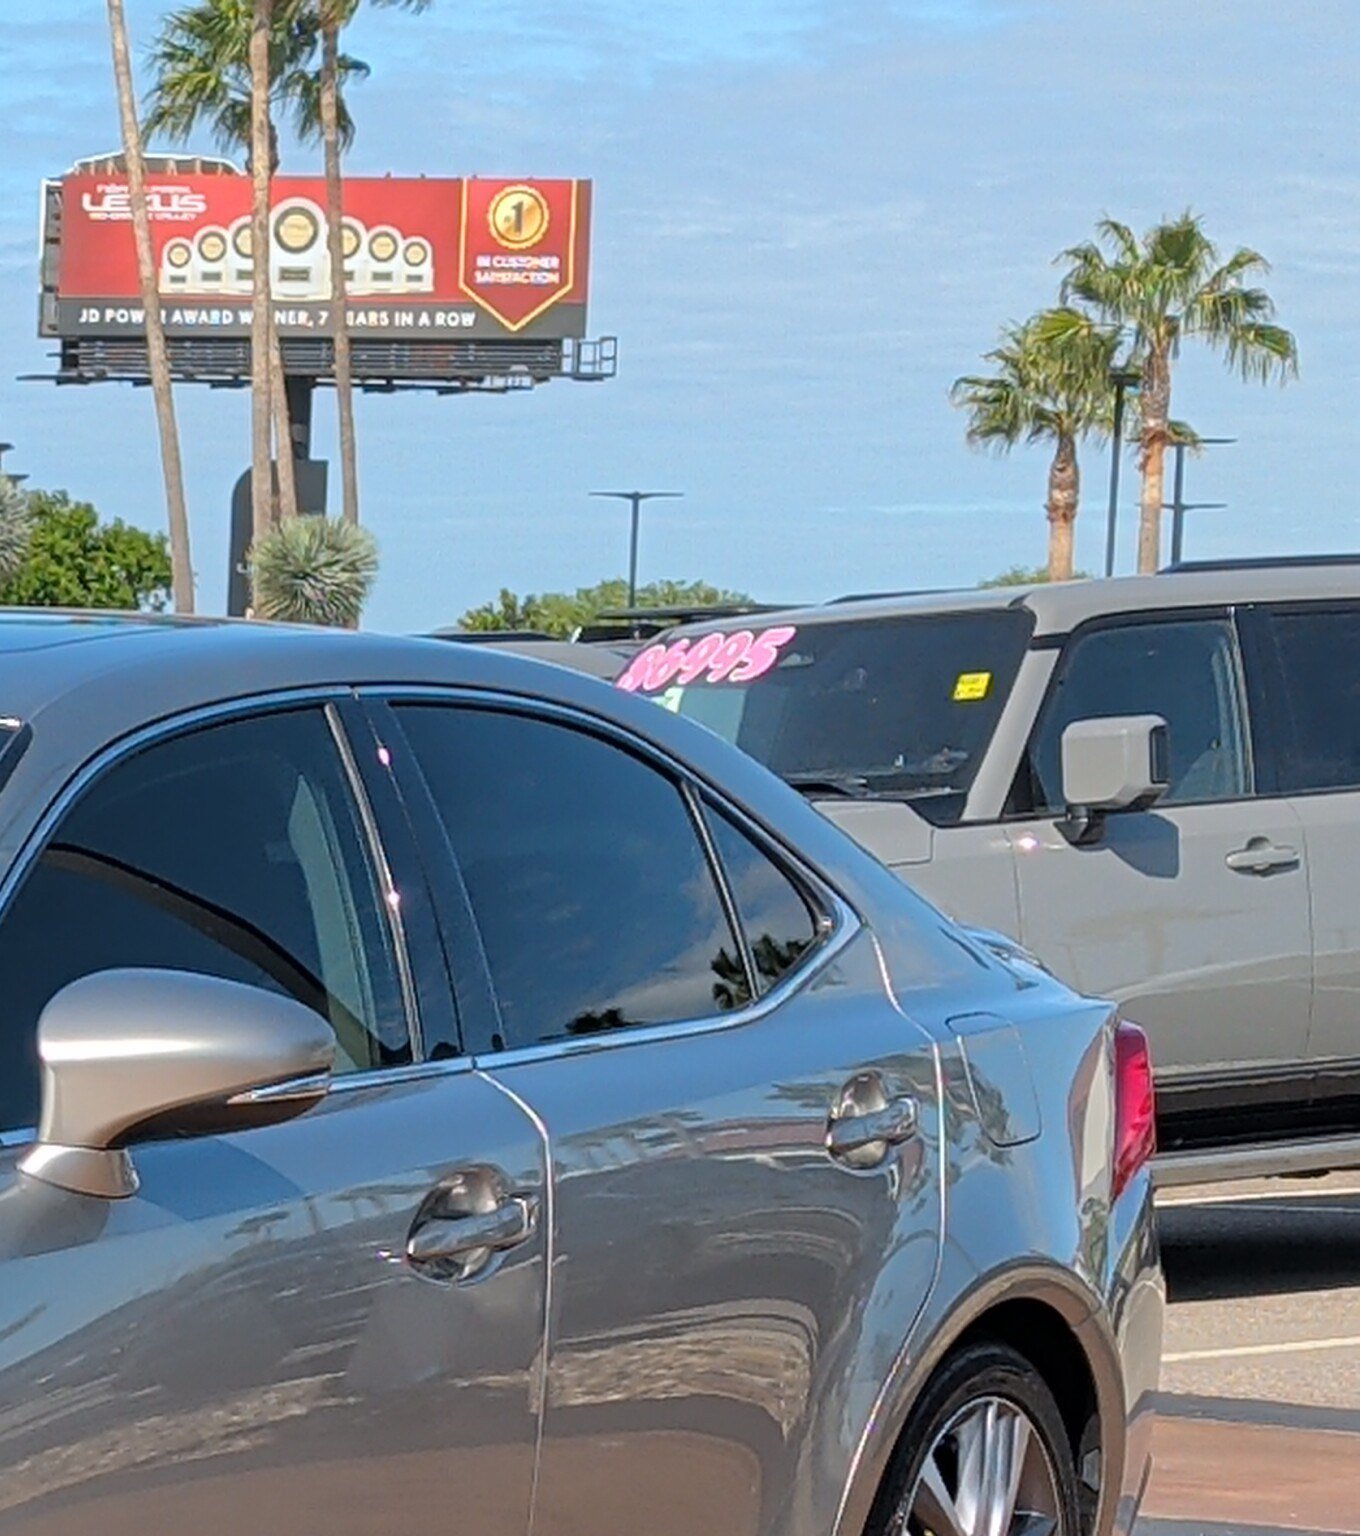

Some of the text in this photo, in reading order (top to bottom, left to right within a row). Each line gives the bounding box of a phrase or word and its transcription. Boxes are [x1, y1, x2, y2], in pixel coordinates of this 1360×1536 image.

[82, 193, 207, 213] LEUS
[79, 308, 100, 323] JD
[171, 309, 233, 325] AWARD
[238, 310, 314, 327] WNER,
[318, 310, 329, 326] 7
[338, 310, 389, 327] EARS
[394, 311, 413, 327] IN
[418, 311, 431, 327] A
[435, 311, 476, 327] ROW
